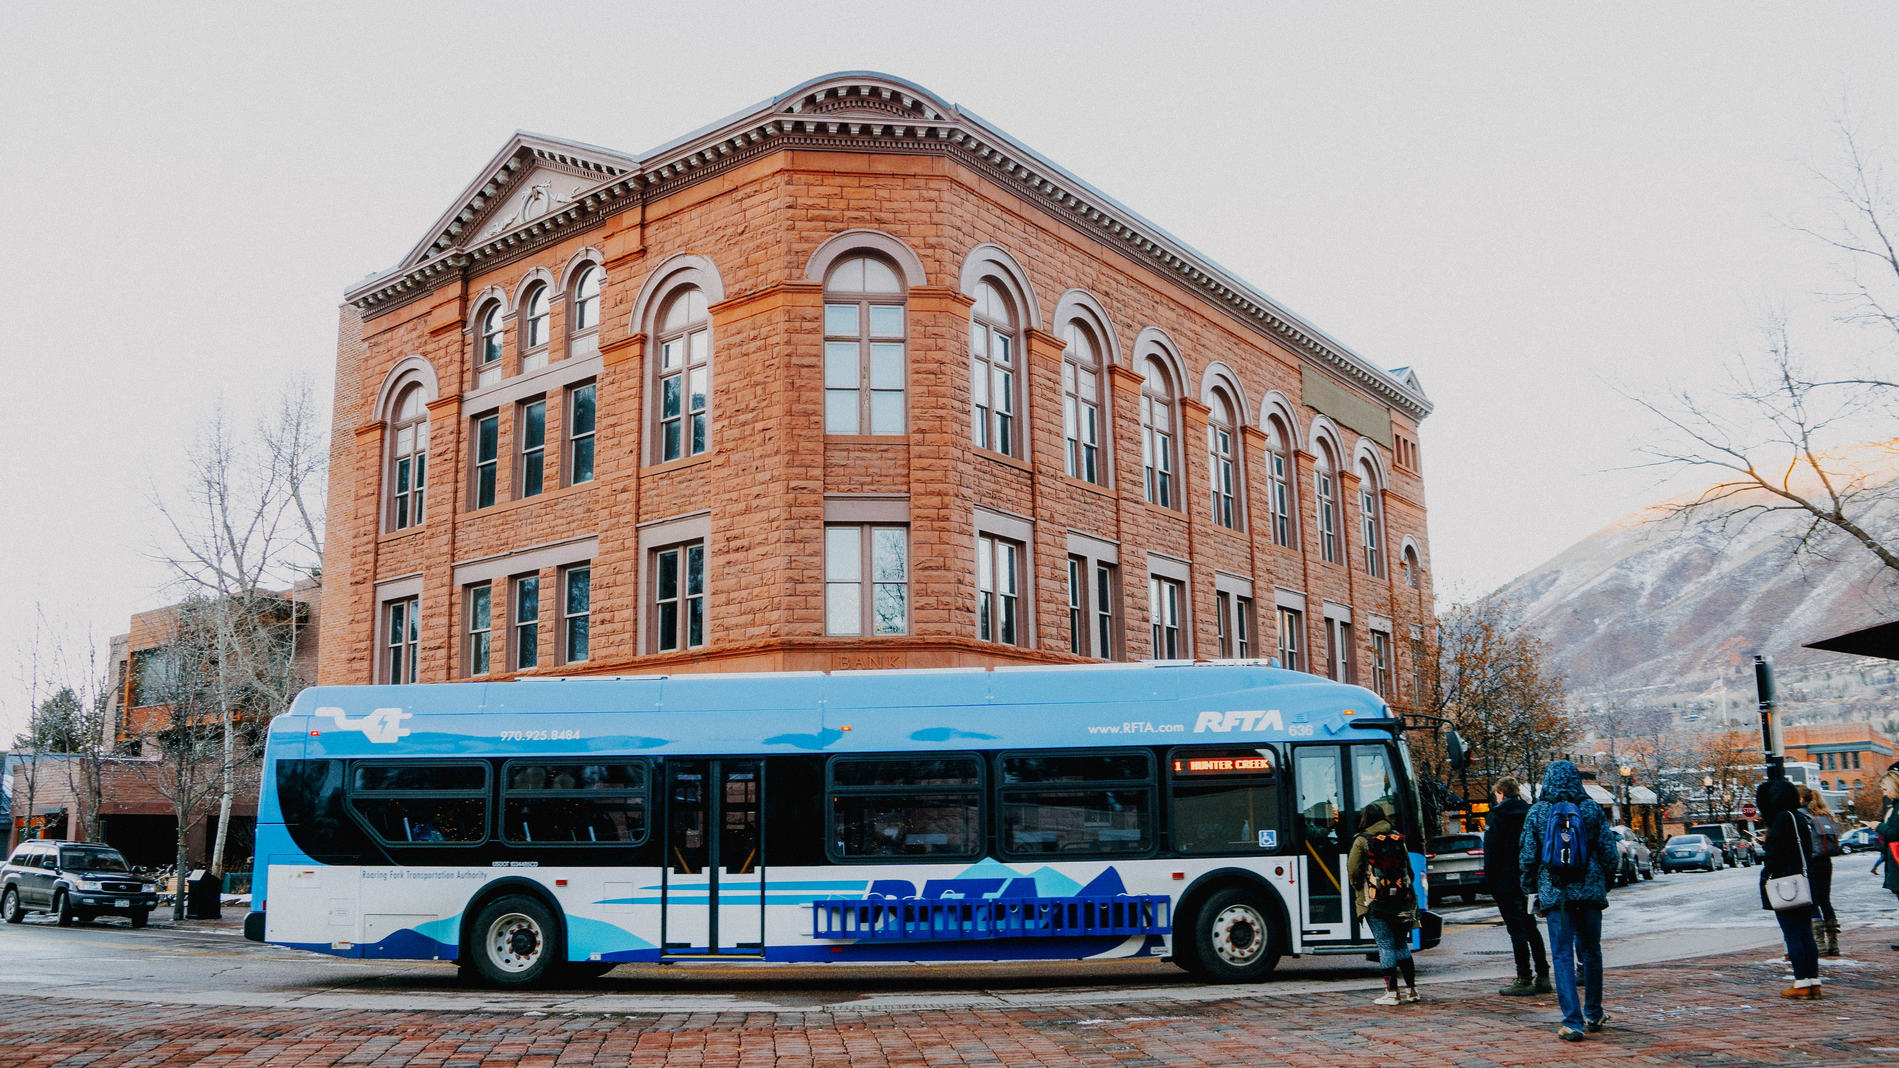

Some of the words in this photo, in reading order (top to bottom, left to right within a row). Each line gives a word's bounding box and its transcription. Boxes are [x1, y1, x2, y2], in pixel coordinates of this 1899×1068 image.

[839, 656, 900, 670] BANK
[1193, 709, 1284, 733] RFTA
[1088, 721, 1184, 735] www.RFTA.com
[1288, 724, 1314, 737] 636
[500, 729, 581, 741] 970.925.8484
[1174, 761, 1182, 771] 1
[1189, 760, 1233, 771] HUNTER
[1234, 759, 1269, 770] CREEK
[362, 869, 388, 881] Roaring
[389, 869, 405, 879] Fork
[406, 870, 455, 881] Transportation
[456, 869, 488, 881] Authority
